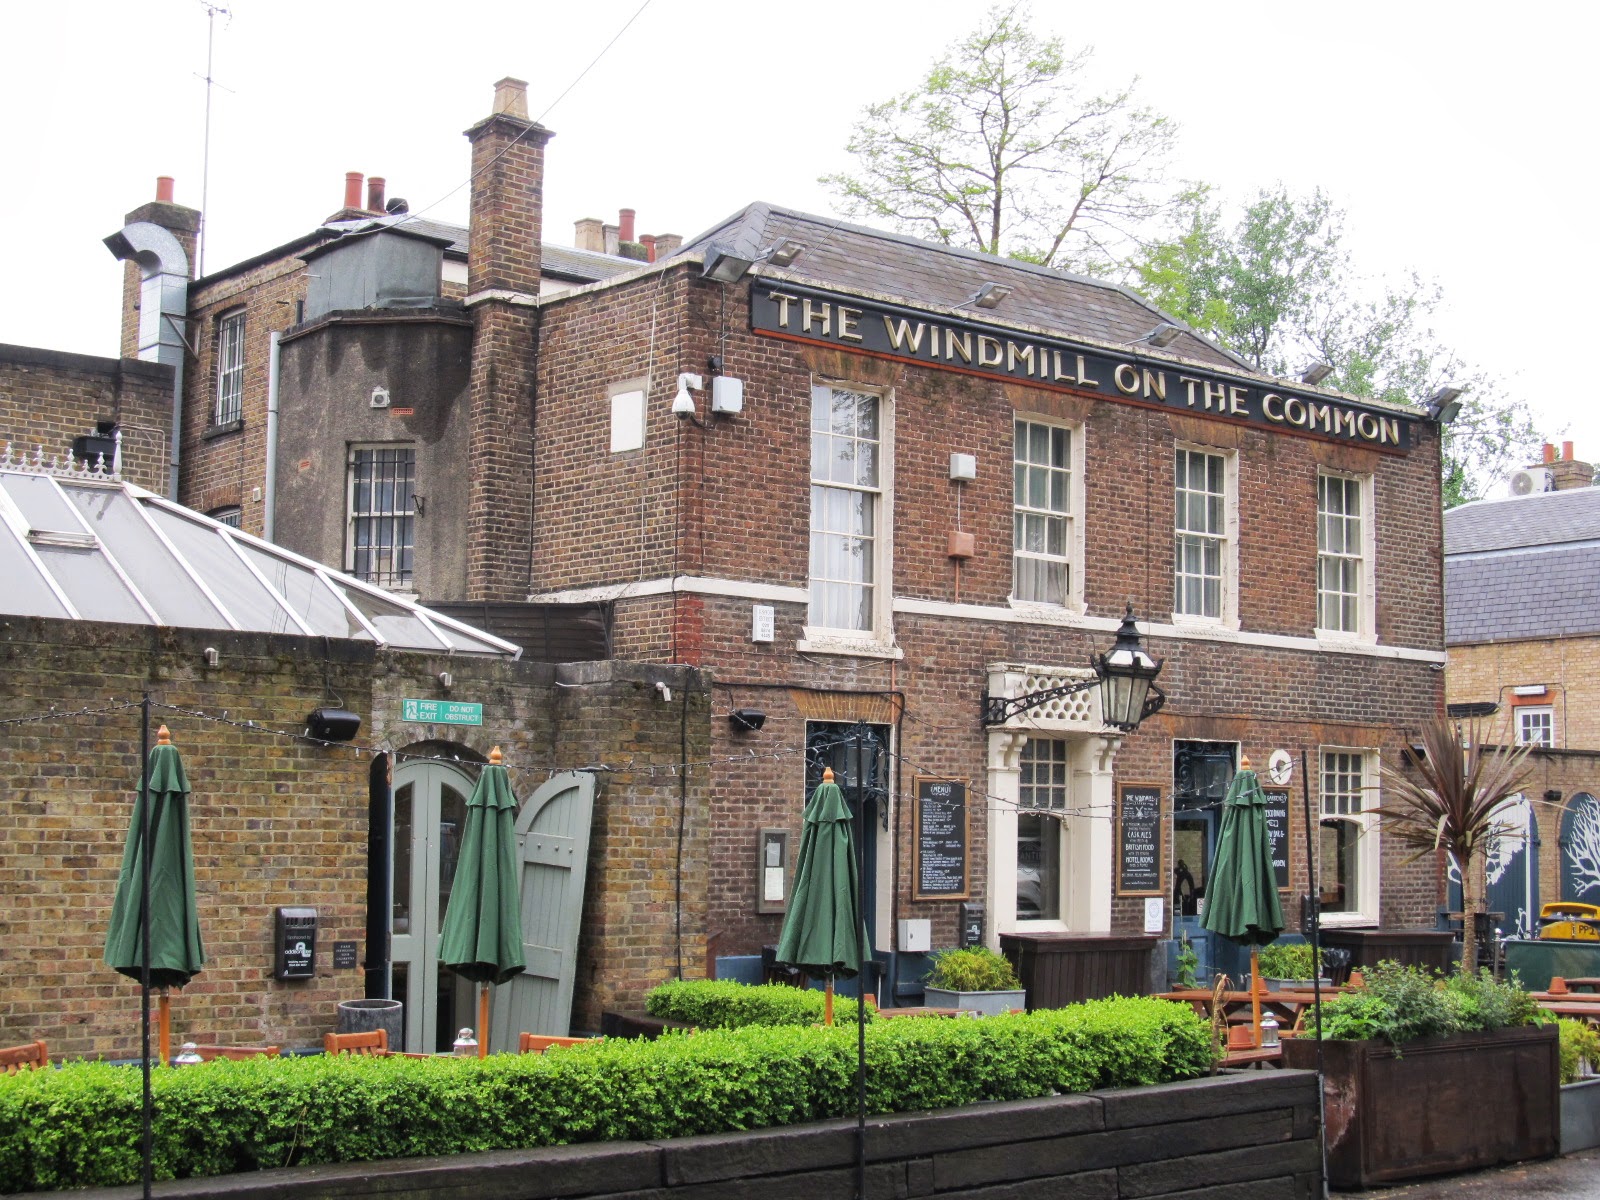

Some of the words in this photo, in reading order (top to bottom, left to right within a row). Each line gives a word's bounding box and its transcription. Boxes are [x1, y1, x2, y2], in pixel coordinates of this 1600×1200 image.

[769, 291, 864, 343] THE
[883, 315, 1099, 388] WINDMILL
[1113, 363, 1167, 400] ON
[1180, 375, 1249, 416] THE
[1262, 393, 1400, 447] COMMON
[420, 702, 438, 711] FIRE
[449, 705, 460, 713] DO
[461, 706, 474, 714] NOT
[419, 711, 438, 720] EXIT
[444, 713, 479, 722] OBSTRUCT
[1127, 831, 1140, 839] CASK
[1140, 831, 1152, 839] ALES
[1125, 843, 1143, 851] BRITISH
[1125, 856, 1140, 864] HOTEL
